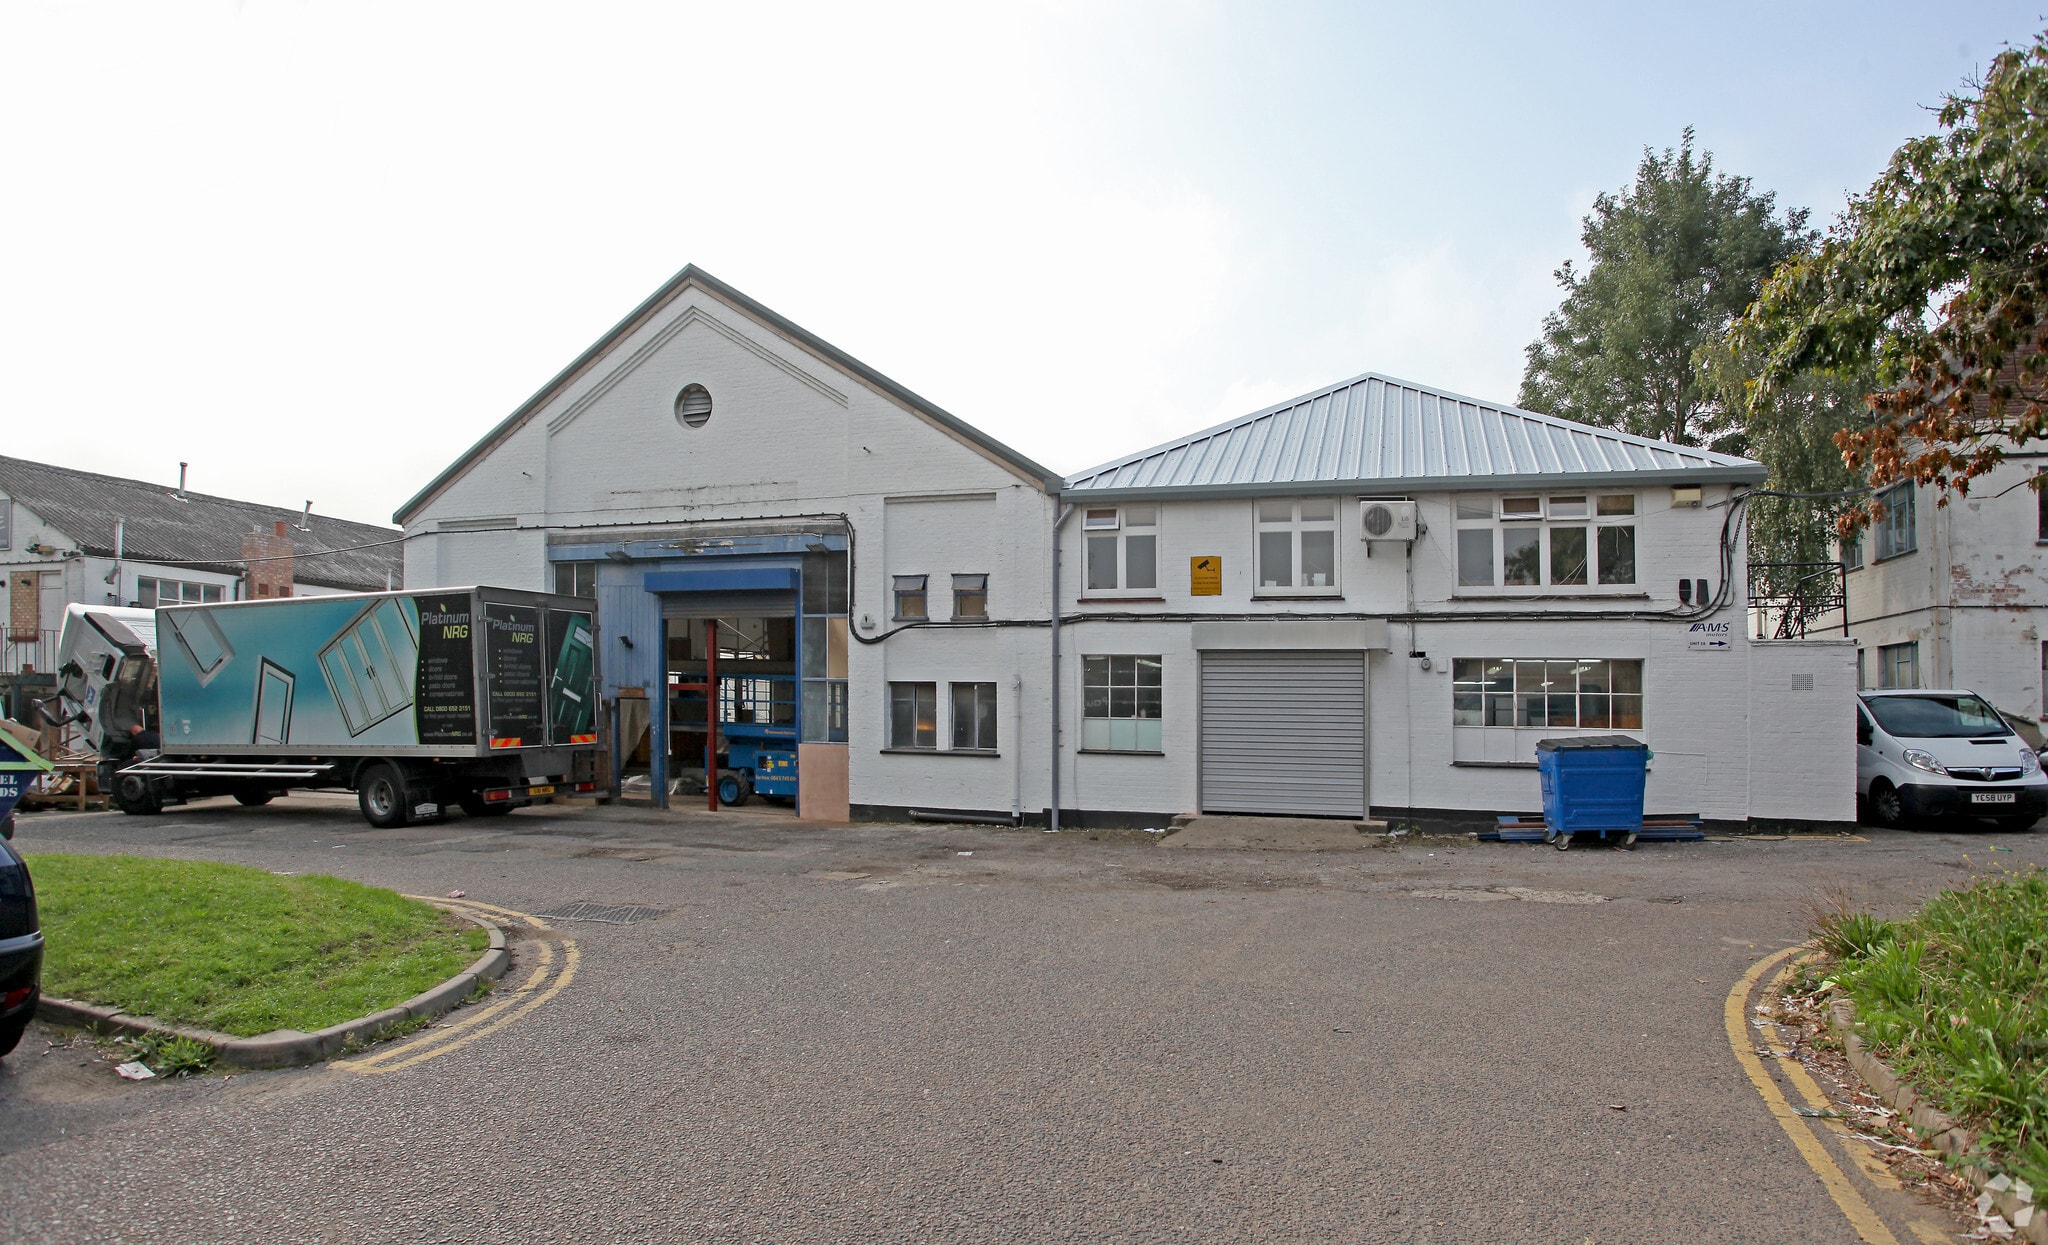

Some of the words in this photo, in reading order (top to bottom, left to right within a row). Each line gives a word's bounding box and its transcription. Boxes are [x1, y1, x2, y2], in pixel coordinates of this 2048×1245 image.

[421, 610, 469, 625] Platinum
[442, 624, 469, 640] NRG
[492, 618, 535, 632] Platinum
[511, 632, 534, 644] NRG
